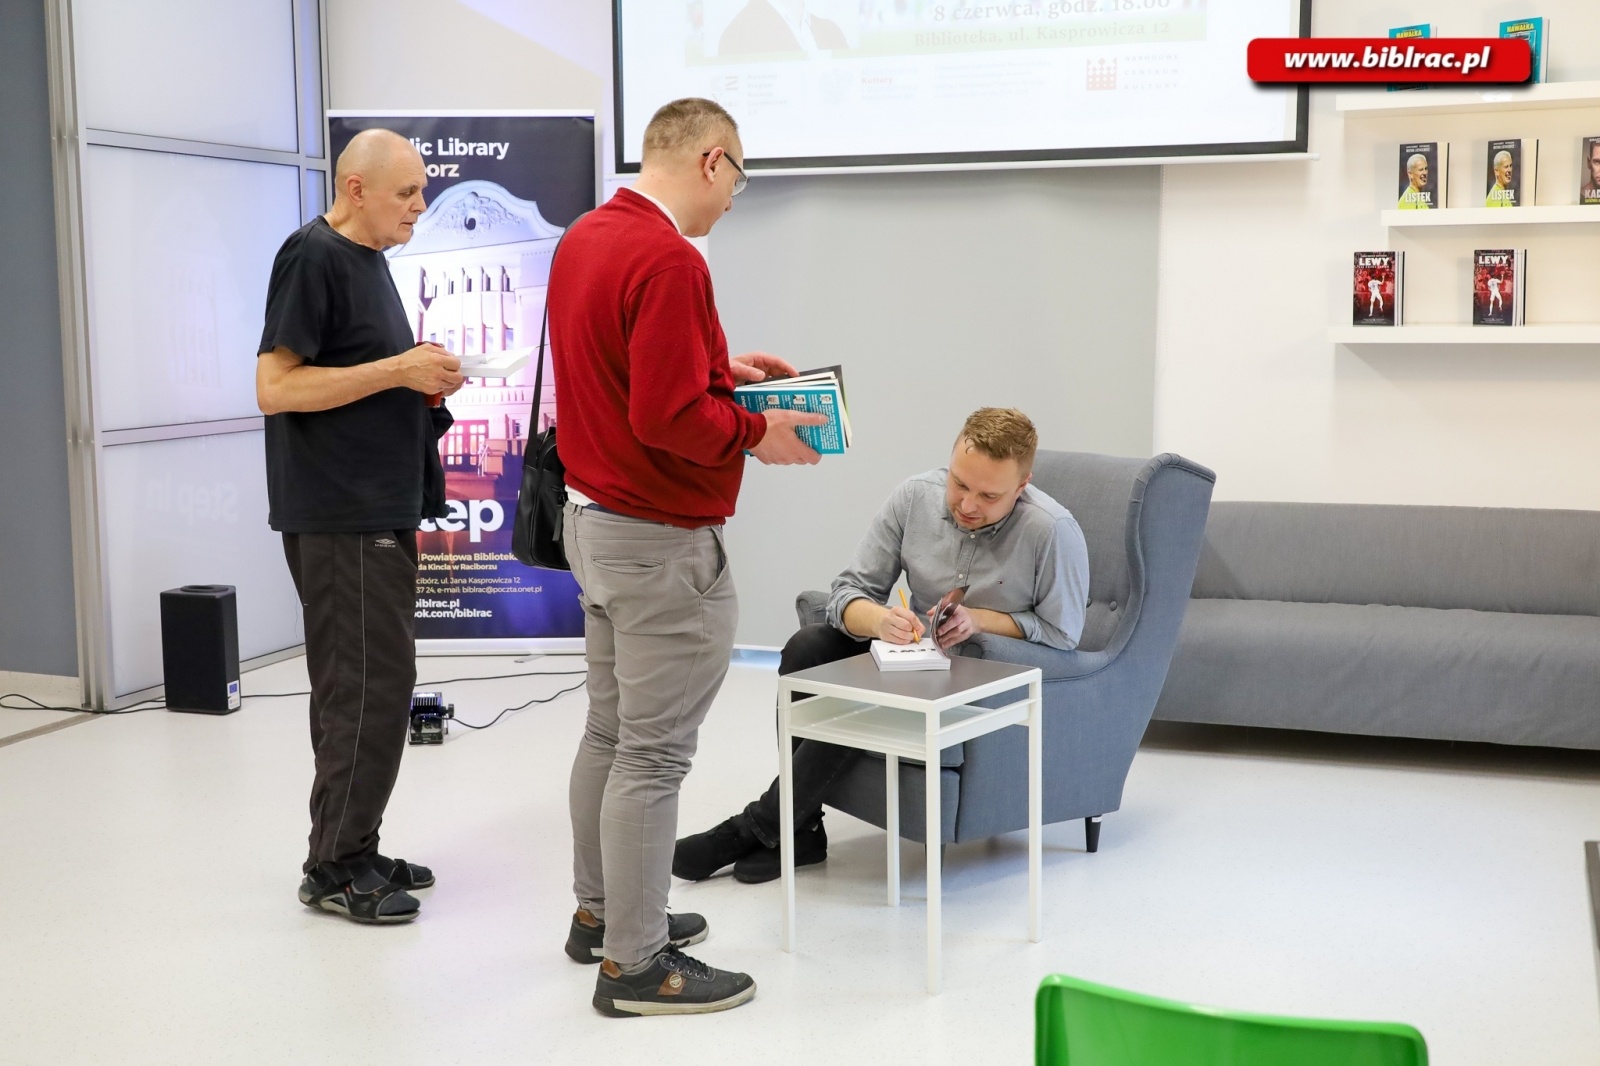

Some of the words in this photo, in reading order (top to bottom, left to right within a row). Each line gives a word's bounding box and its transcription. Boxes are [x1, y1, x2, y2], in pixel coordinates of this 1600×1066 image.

[934, 5, 945, 22] 8
[953, 3, 1040, 21] czerwca,
[1048, 0, 1104, 19] godz.
[914, 29, 1003, 48] Biblioteka,
[1009, 27, 1030, 42] ul.
[1036, 22, 1146, 42] Kasprowicza
[1152, 22, 1170, 34] 12
[1125, 54, 1178, 62] NARODOWE
[861, 76, 893, 85] Kultury
[437, 137, 509, 160] Library
[425, 163, 460, 178] orz
[1405, 191, 1431, 203] LISTEK
[1491, 189, 1515, 200] LISTEK
[1359, 257, 1389, 266] LEWY
[1479, 255, 1508, 264] LEWY
[421, 553, 472, 562] Powiatowa
[461, 563, 498, 571] Raciborzu
[468, 576, 513, 586] Kasprowicza
[513, 576, 521, 584] 12
[437, 586, 461, 594] e-mail:
[462, 585, 542, 595] biblrac@poczta.onet.pl
[414, 608, 493, 619] ok.com/biblrac
